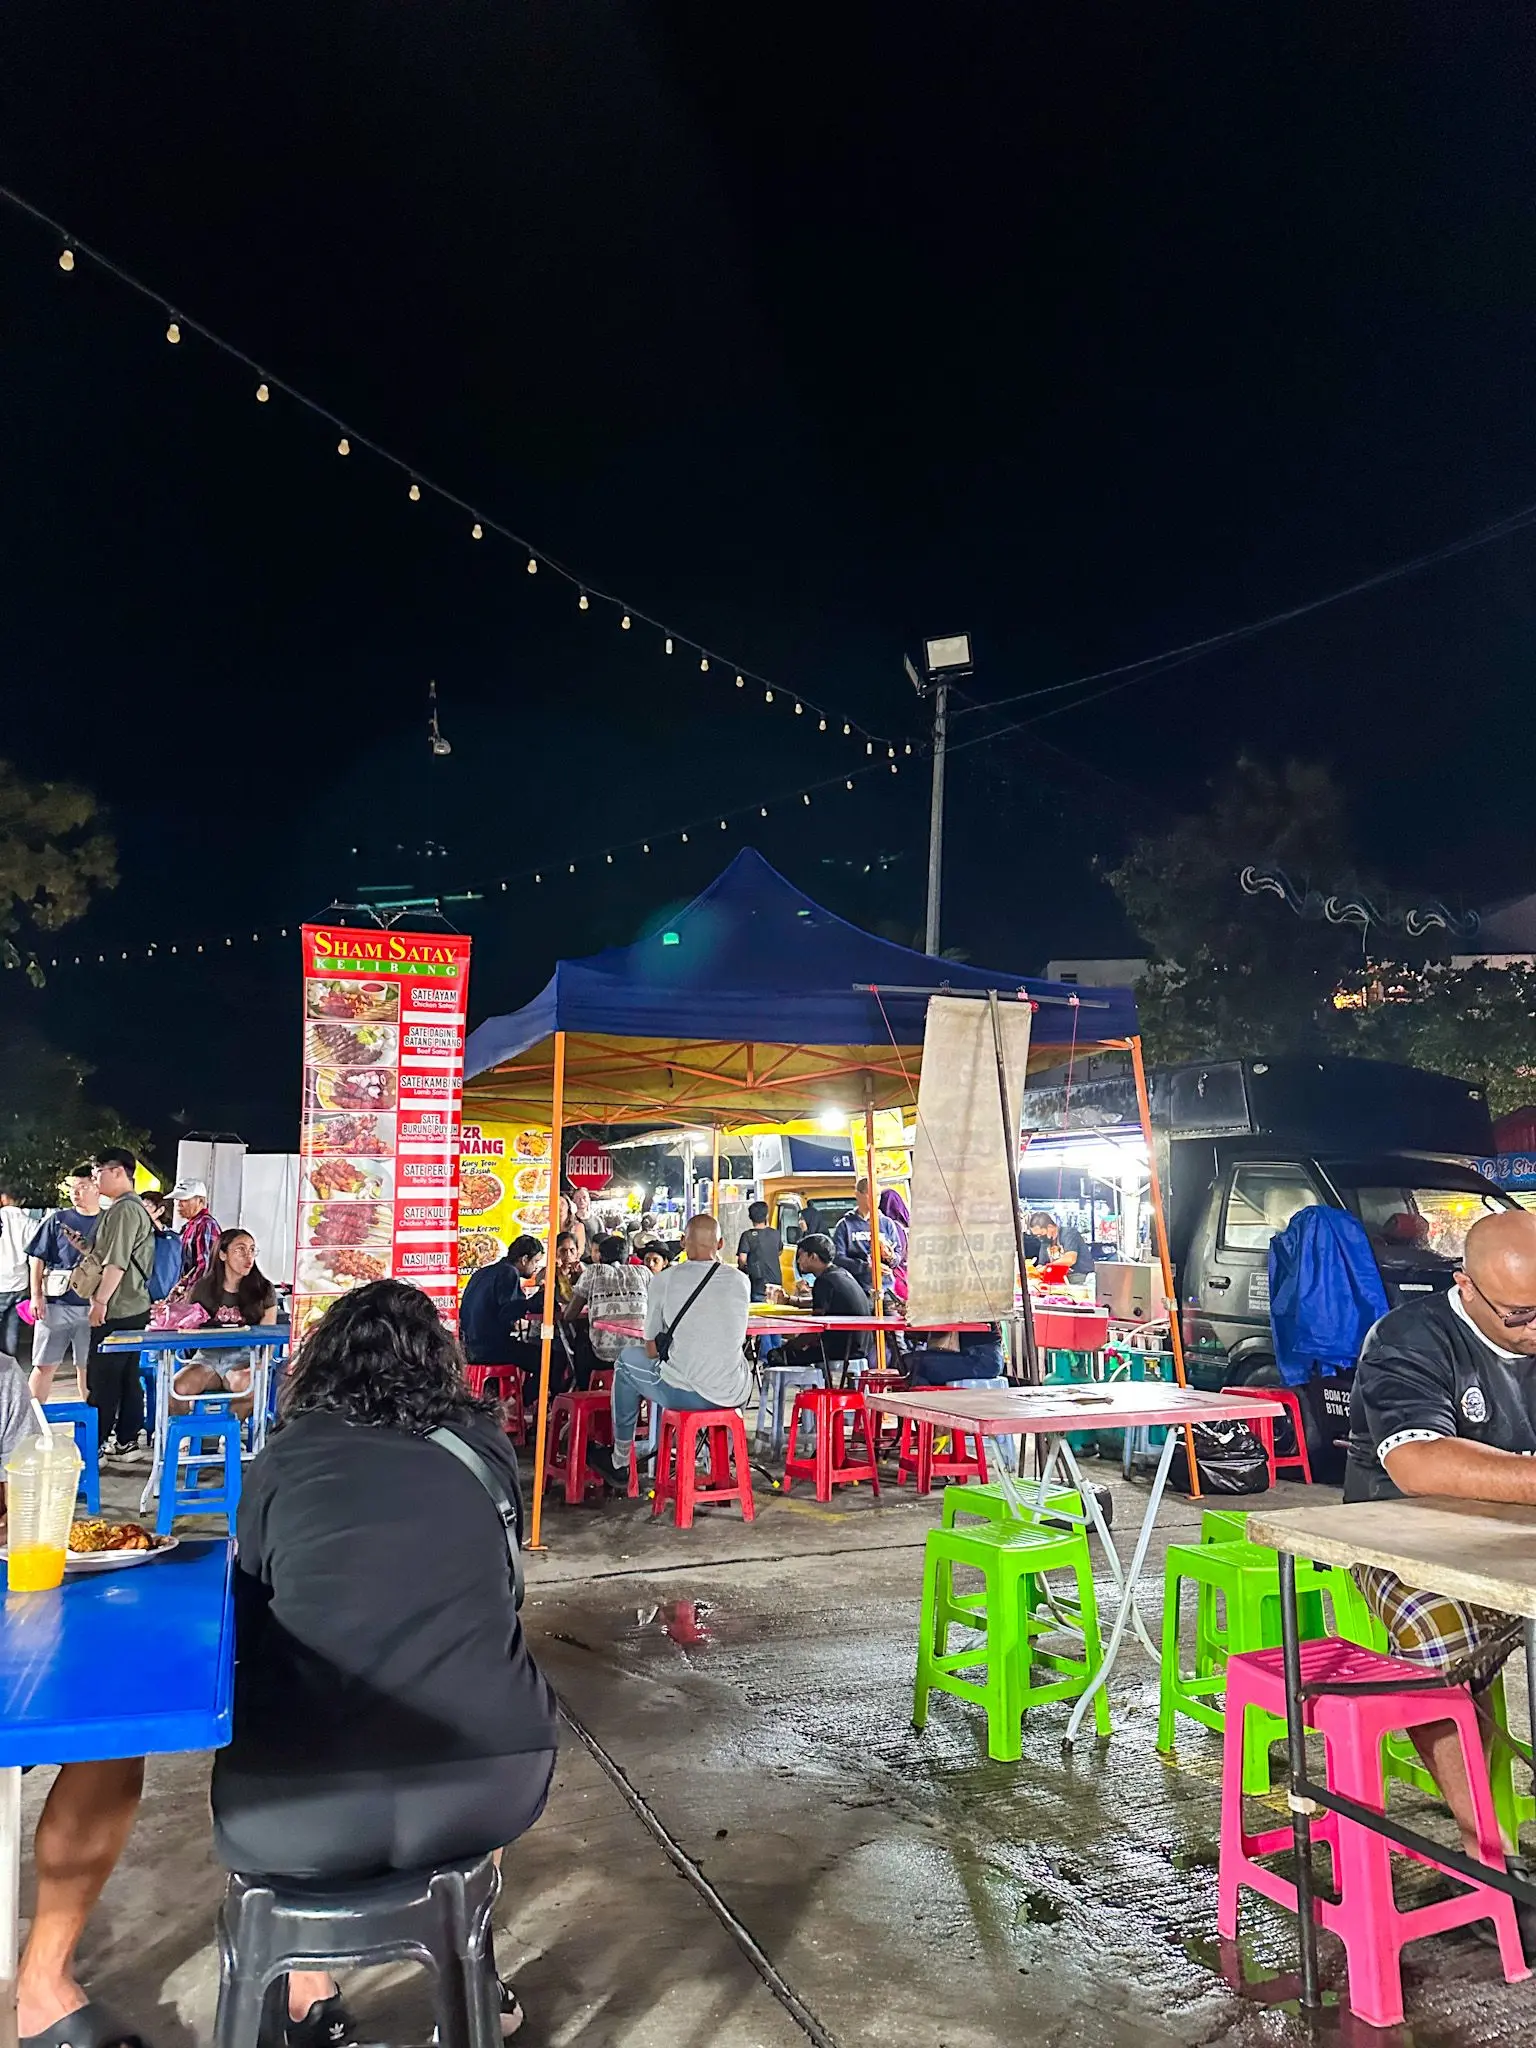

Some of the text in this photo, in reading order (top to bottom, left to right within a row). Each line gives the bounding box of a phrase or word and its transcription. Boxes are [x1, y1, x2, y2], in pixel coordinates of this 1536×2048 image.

[316, 958, 457, 976] KELIBANG
[412, 989, 458, 1002] SATE AYAM
[410, 1027, 457, 1039] SATE DAGING
[404, 1036, 462, 1049] BATANG PINANG
[401, 1076, 462, 1089] SATE KAMBING
[422, 1115, 440, 1125] SATE
[403, 1124, 433, 1134] BURUNG
[463, 1126, 481, 1140] ZR
[459, 1140, 504, 1155] NANG
[405, 1164, 455, 1176] SATE PERUT
[568, 1155, 611, 1175] BERHENTI
[404, 1207, 452, 1218] SATE KULIT
[404, 1253, 449, 1265] NASI IMPIT
[1326, 1402, 1344, 1416] BTM
